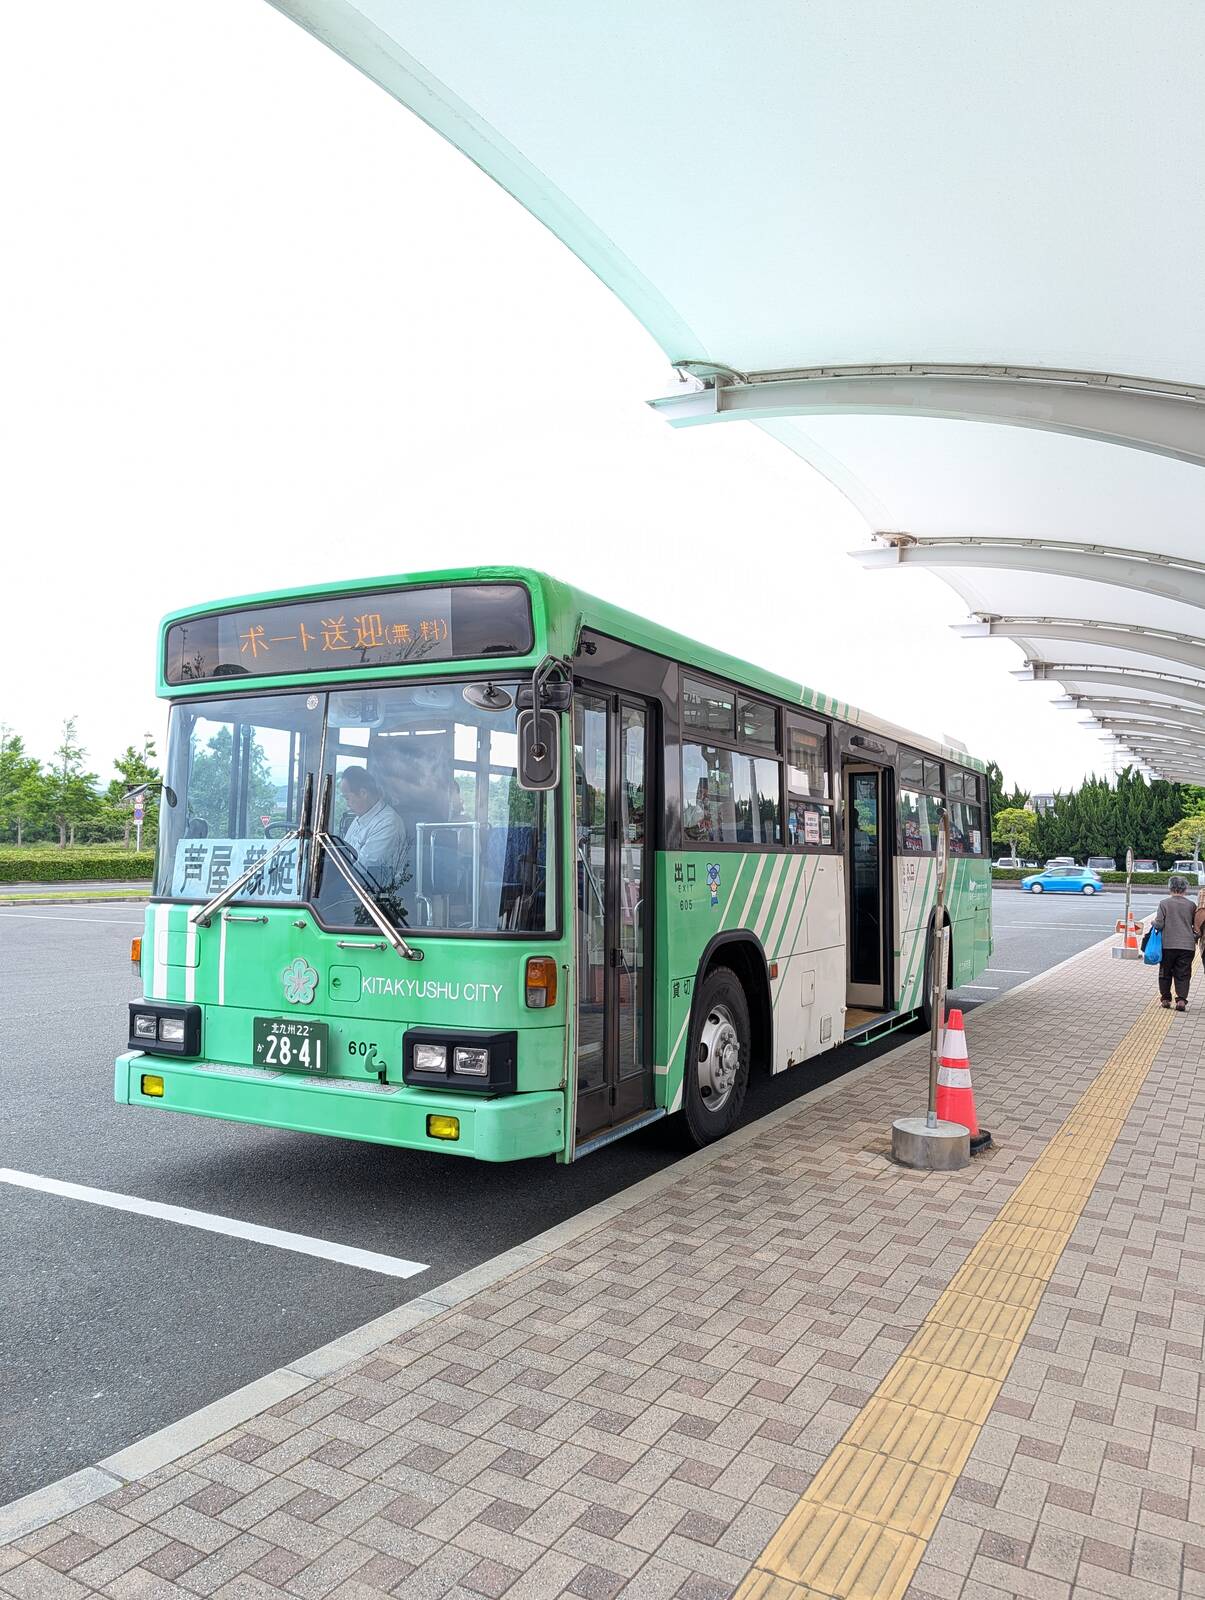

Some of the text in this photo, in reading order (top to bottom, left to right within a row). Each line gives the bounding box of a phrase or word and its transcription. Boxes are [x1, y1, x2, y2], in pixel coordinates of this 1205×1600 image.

[674, 862, 696, 882] 出口
[678, 884, 694, 893] EXIT
[679, 899, 693, 911] 605
[362, 976, 503, 1003] KITAKYUSHU CITY
[256, 1035, 321, 1068] か 28-41
